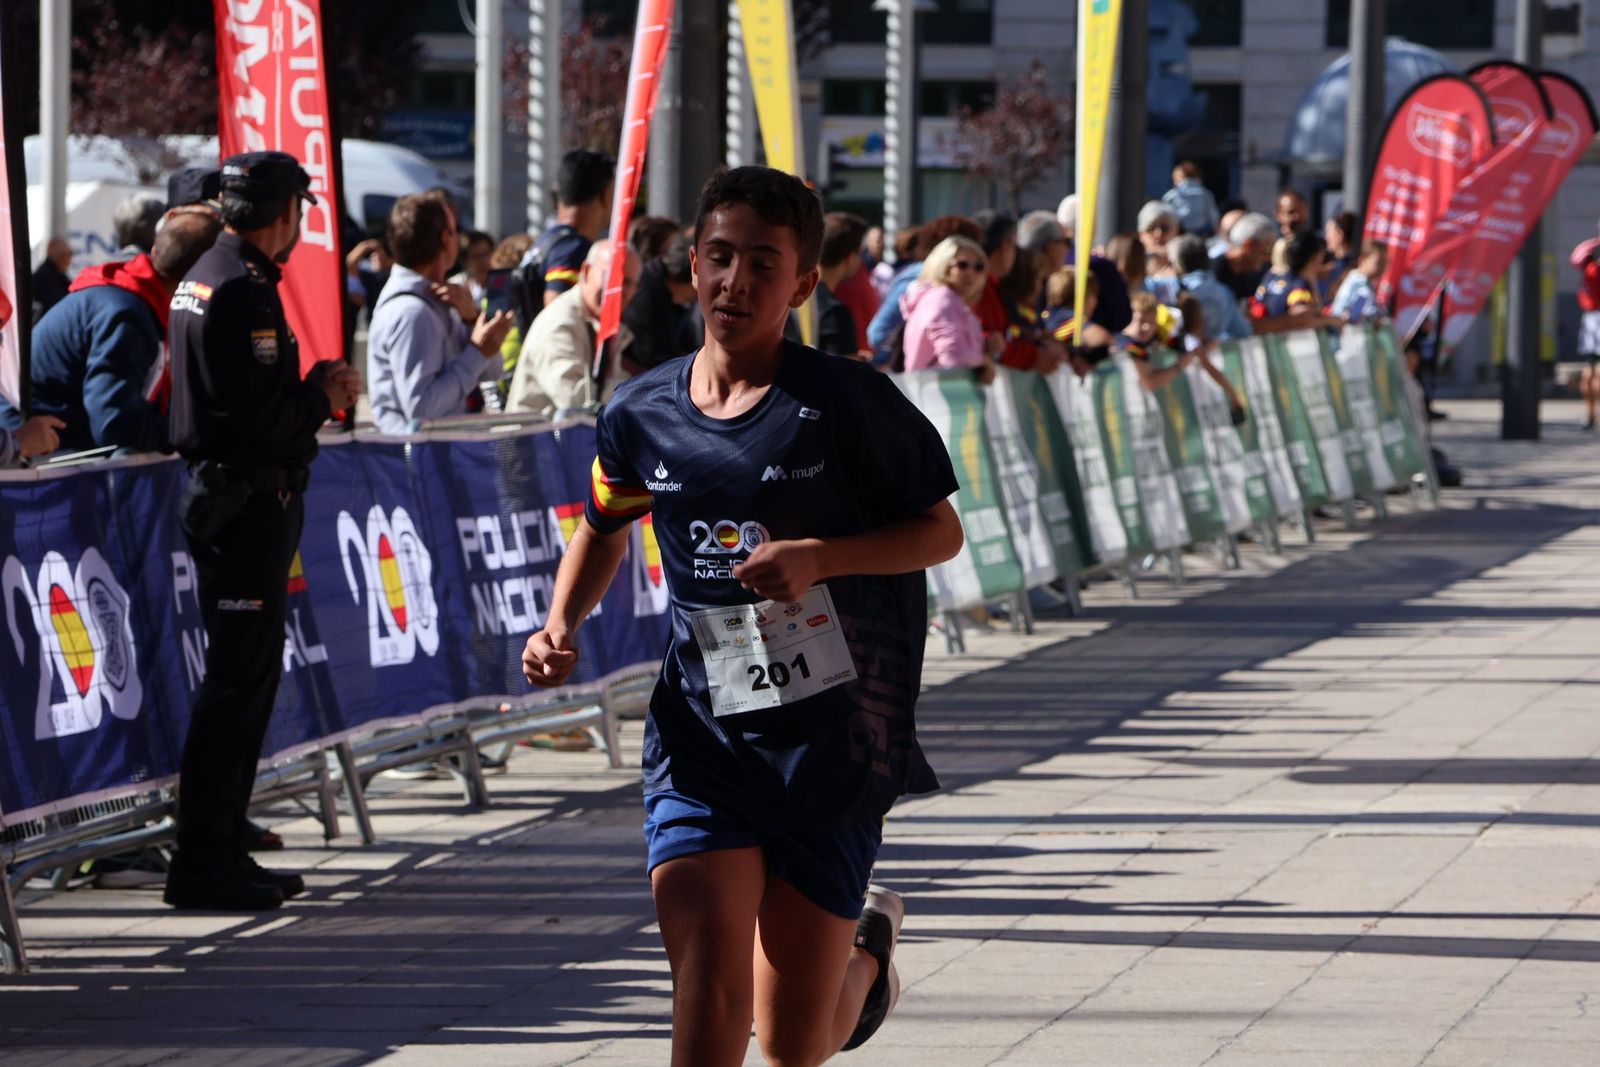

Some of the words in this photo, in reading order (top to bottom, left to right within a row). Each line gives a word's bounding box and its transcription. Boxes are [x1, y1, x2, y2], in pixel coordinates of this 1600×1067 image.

[645, 480, 682, 492] Santander
[791, 459, 825, 479] mupol
[689, 519, 771, 554] 200
[694, 558, 746, 568] POLIC
[337, 504, 439, 668] 200
[2, 546, 143, 740] 200
[747, 652, 811, 691] 201
